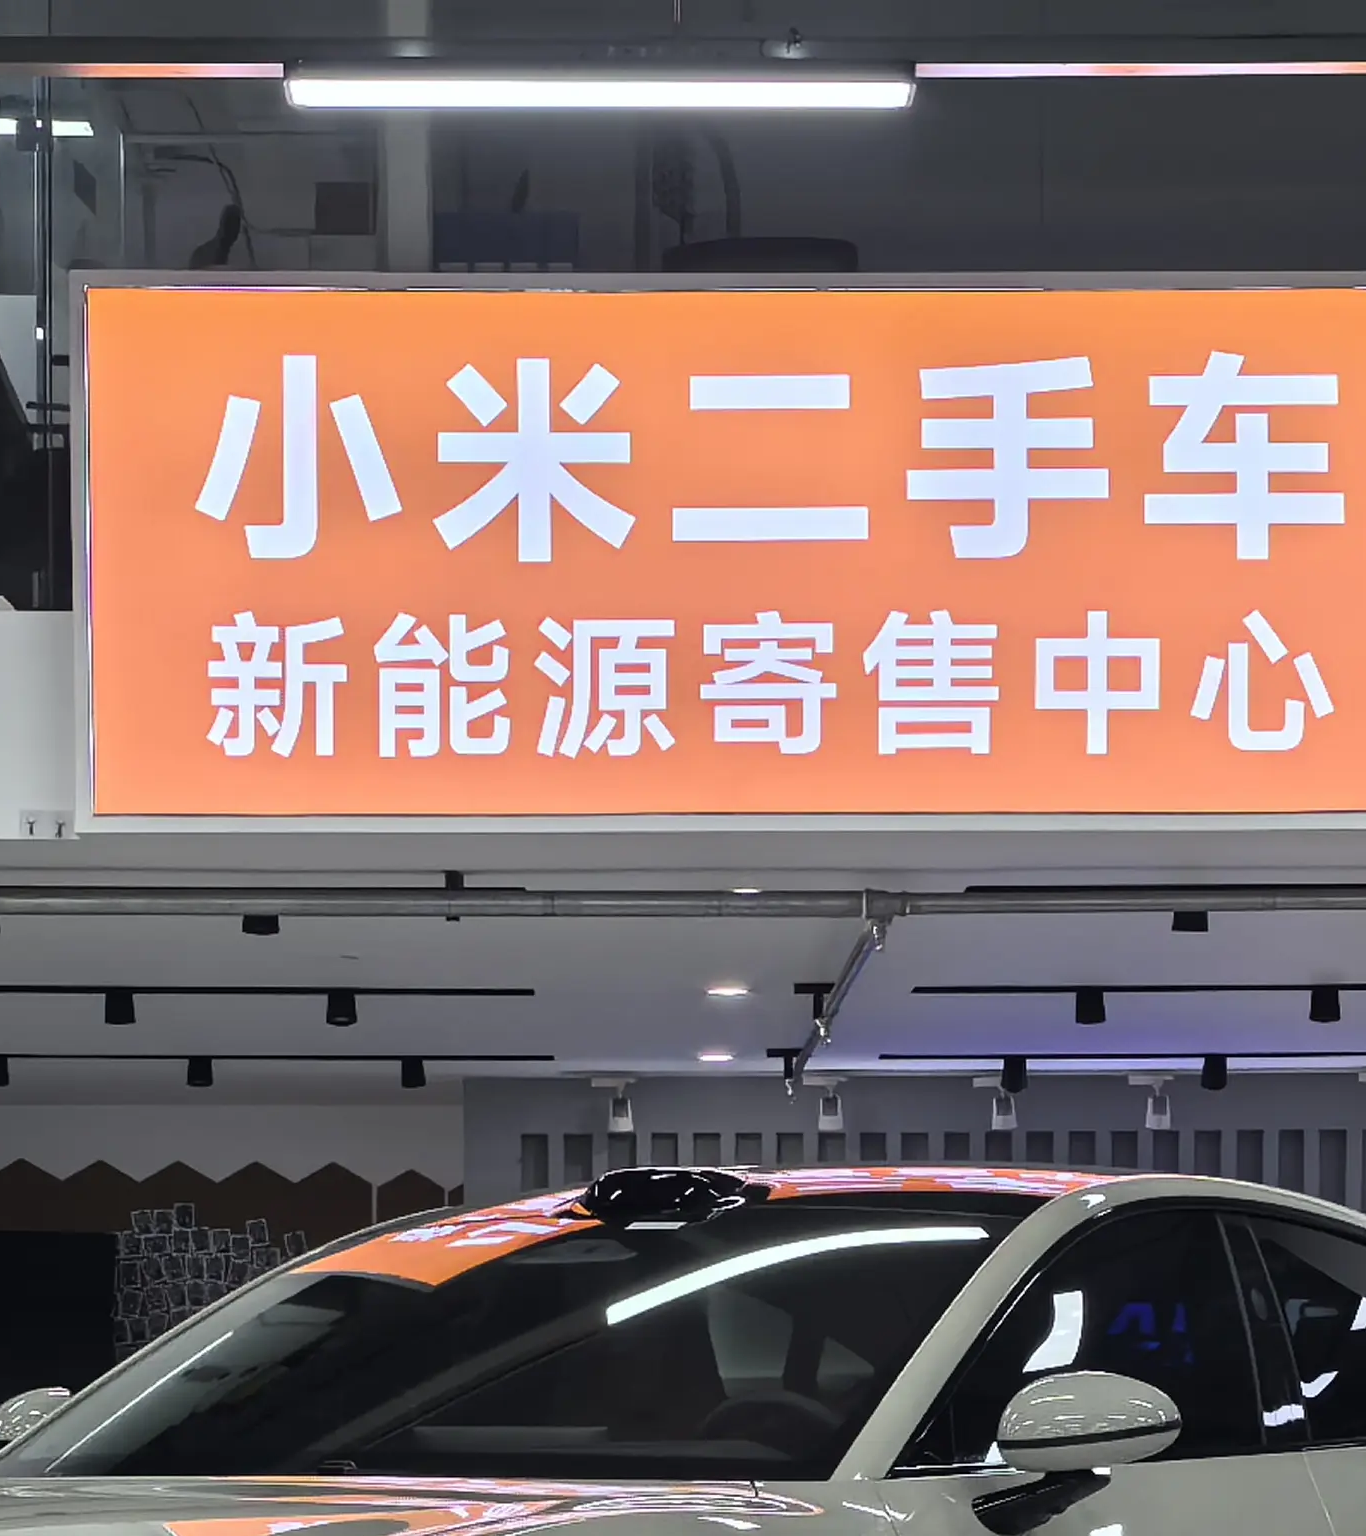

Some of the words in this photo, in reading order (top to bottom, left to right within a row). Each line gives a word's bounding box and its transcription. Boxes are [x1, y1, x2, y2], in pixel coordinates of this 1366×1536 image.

[192, 350, 1346, 564] 小米二手车
[205, 608, 1334, 758] 新能源寄售中心
